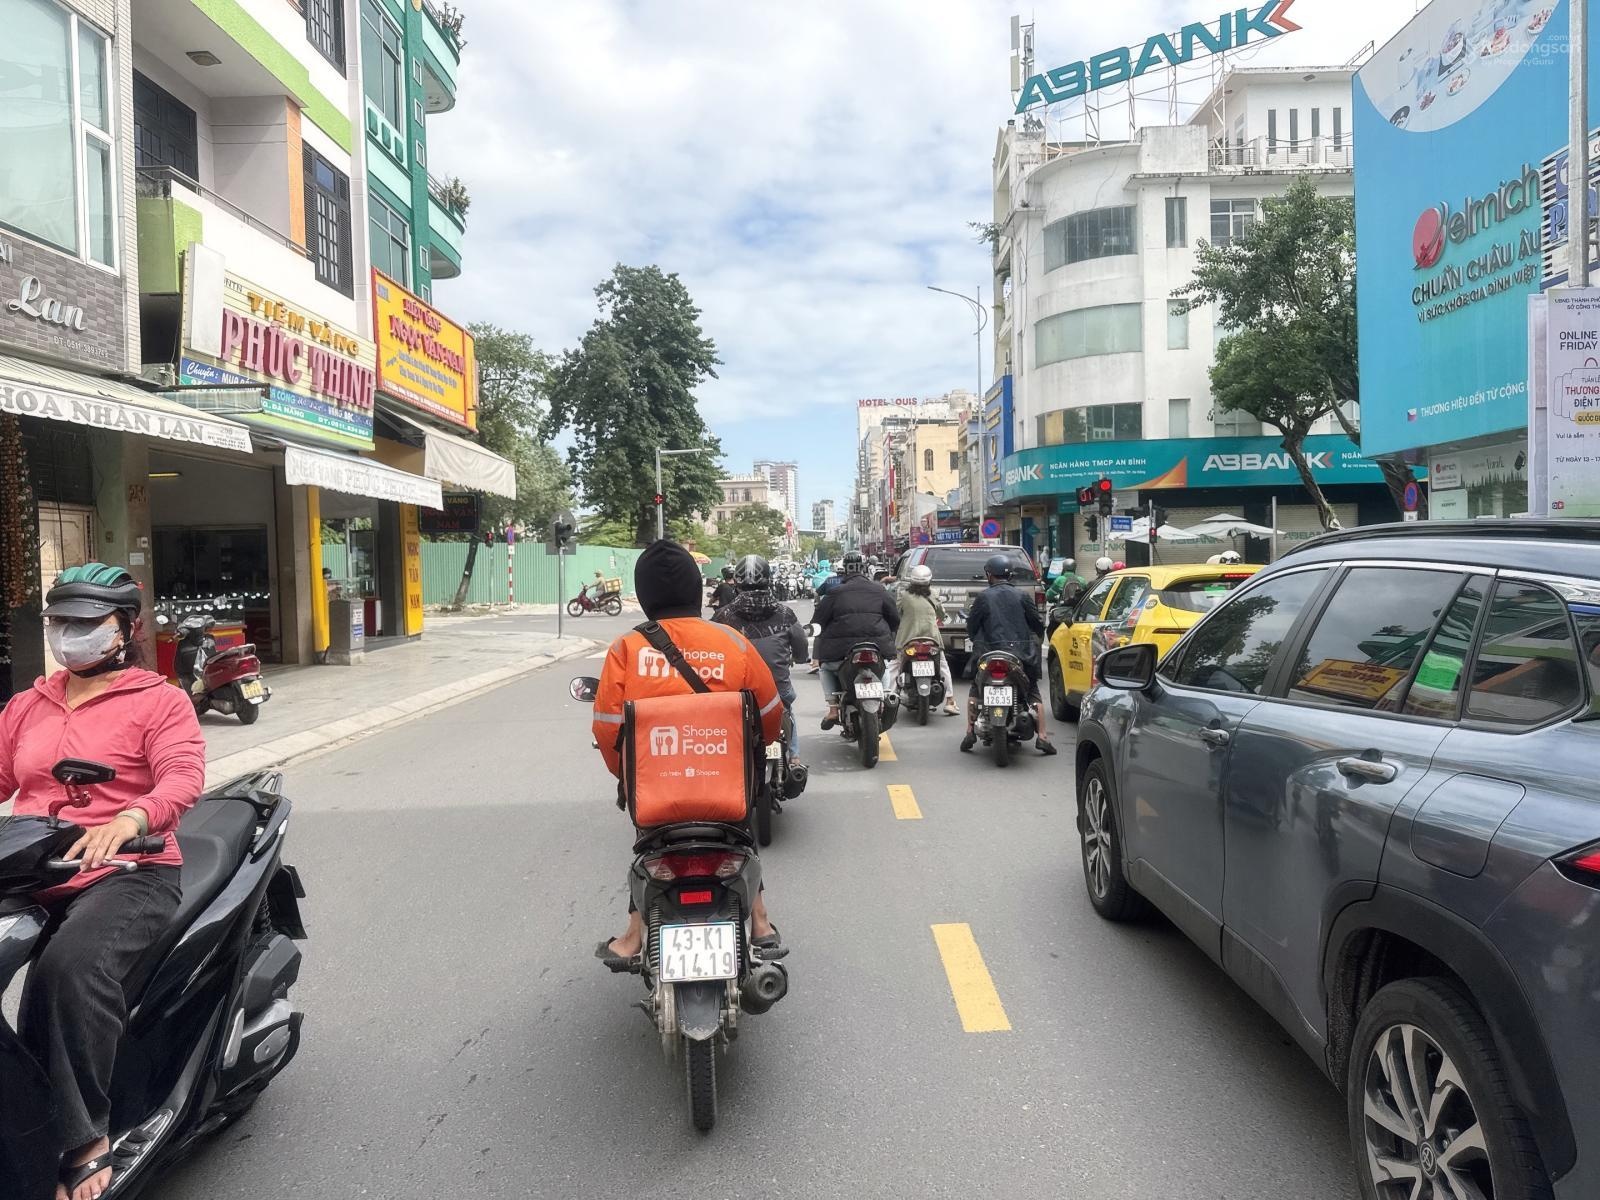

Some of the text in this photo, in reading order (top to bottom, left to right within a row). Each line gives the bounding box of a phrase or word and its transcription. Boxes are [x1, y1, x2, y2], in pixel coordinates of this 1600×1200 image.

[1449, 162, 1541, 244] elmich
[1411, 263, 1464, 306] CHUẨN
[1466, 242, 1514, 281] CHÂU
[6, 276, 87, 331] Lan
[309, 321, 359, 357] VÀNG
[1559, 330, 1598, 340] ONLINE
[1559, 341, 1598, 351] FRIDAY
[220, 307, 304, 385] PHÚC
[307, 344, 375, 412] THỊNH
[858, 397, 918, 408] HOTEL OUIS
[1420, 402, 1450, 417] THƯƠNG
[1451, 395, 1468, 411] HIỆU
[1469, 390, 1486, 405] ĐẾN
[1499, 381, 1526, 399] CỘNG
[158, 417, 203, 441] LAN
[1069, 460, 1090, 468] HÀNG
[1128, 457, 1146, 465] BÌNH
[679, 648, 725, 662] hopee
[682, 725, 728, 739] Shopee
[682, 739, 728, 755] Food
[672, 927, 722, 952] 43-K1
